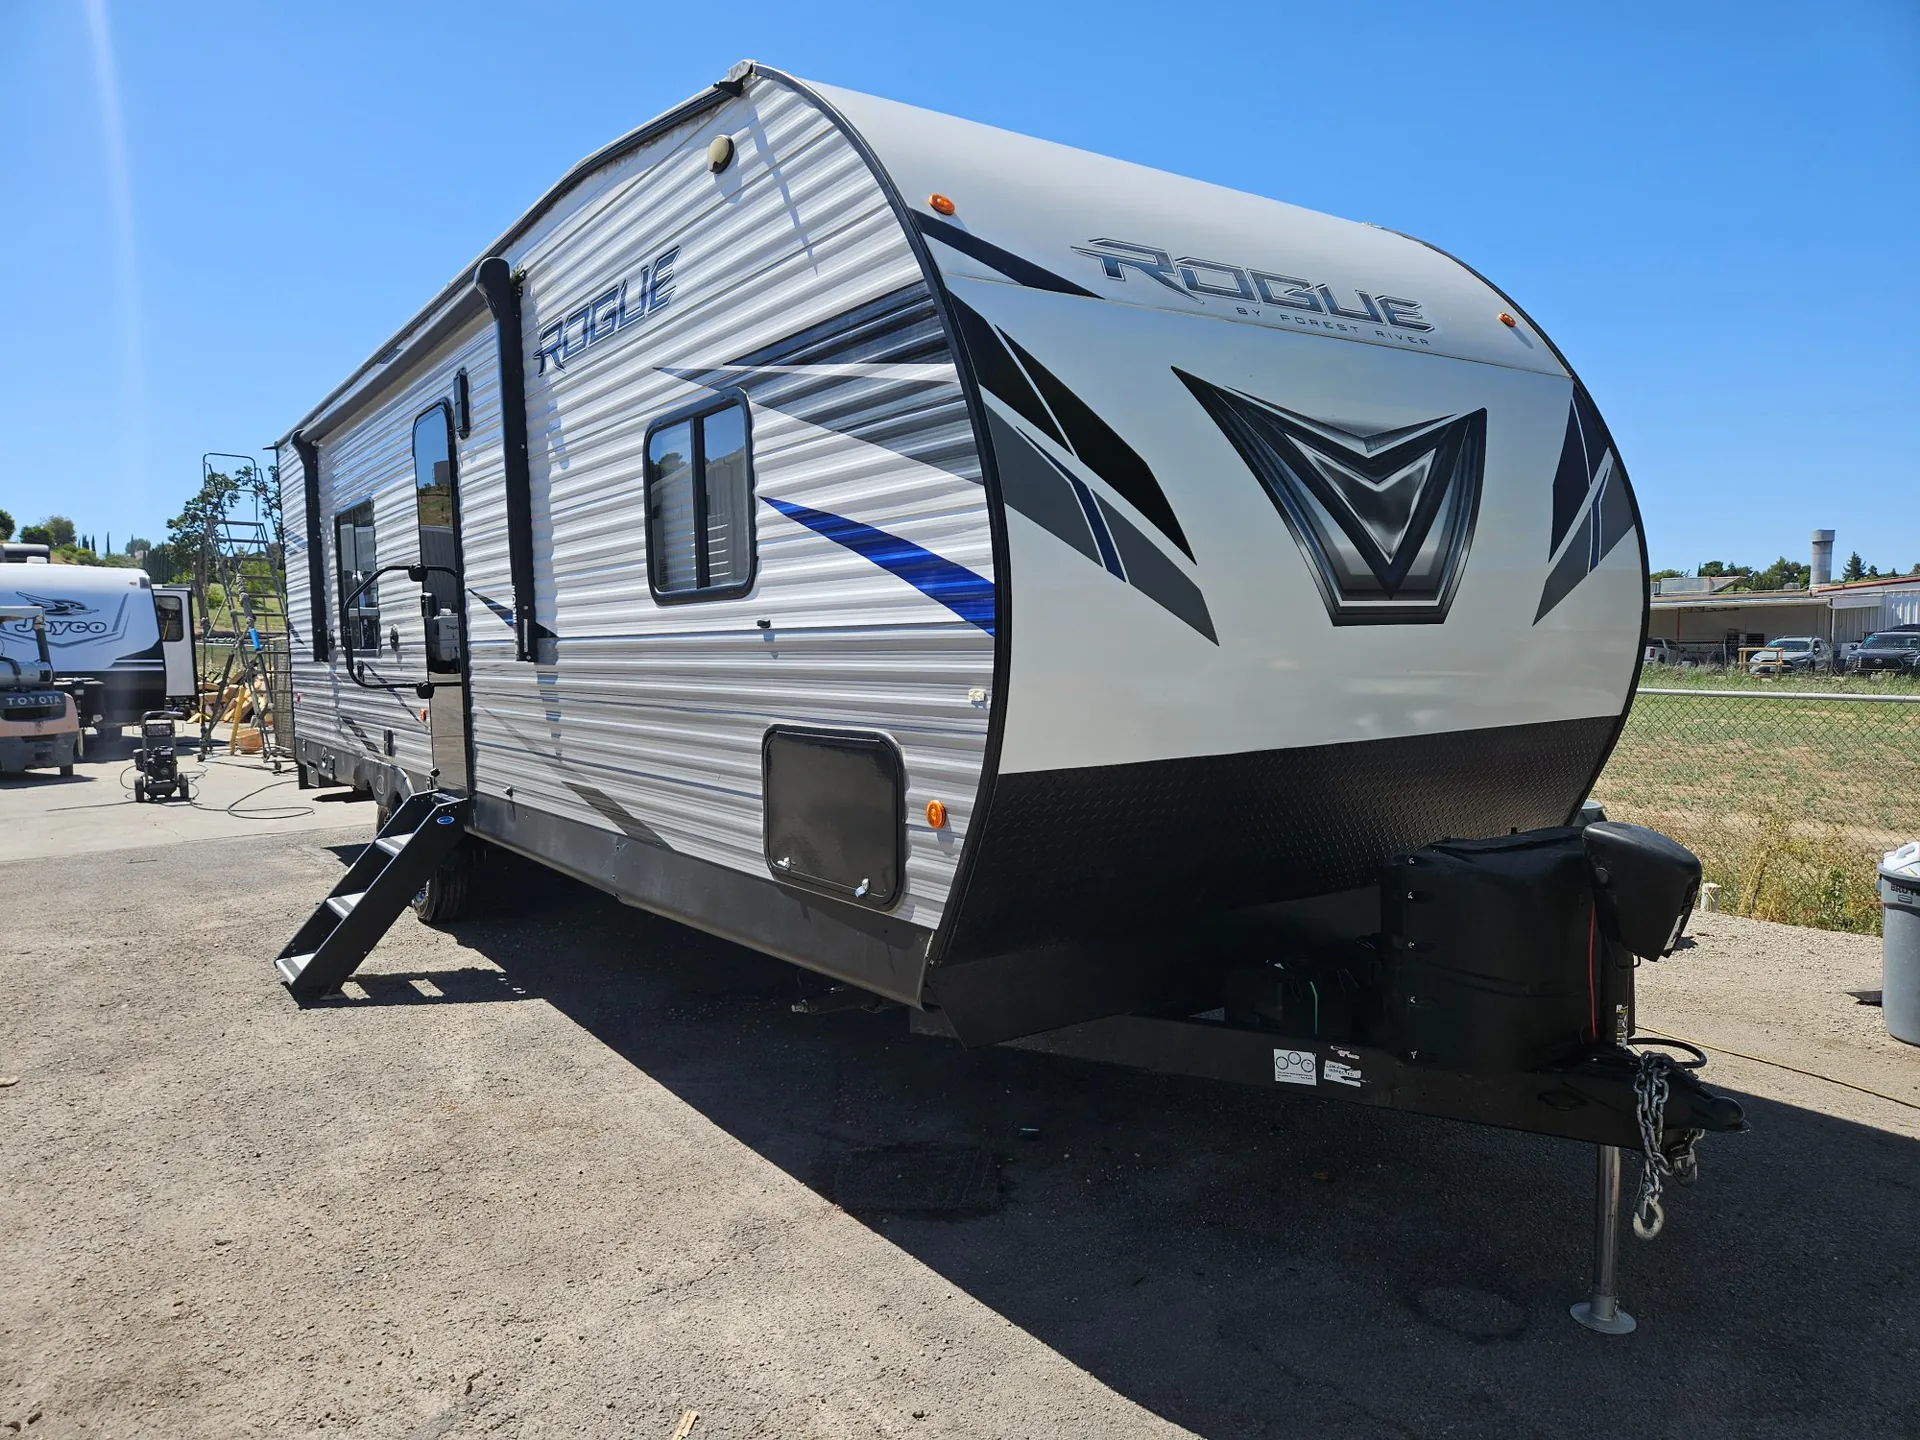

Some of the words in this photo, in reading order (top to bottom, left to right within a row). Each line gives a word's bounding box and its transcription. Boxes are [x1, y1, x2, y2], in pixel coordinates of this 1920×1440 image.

[533, 245, 681, 377] ROGUE
[1070, 237, 1434, 333] ROGUE
[1235, 306, 1261, 317] BY
[1280, 314, 1359, 333] FOREST
[1375, 330, 1431, 346] RIVER
[6, 695, 62, 706] TOYOTA
